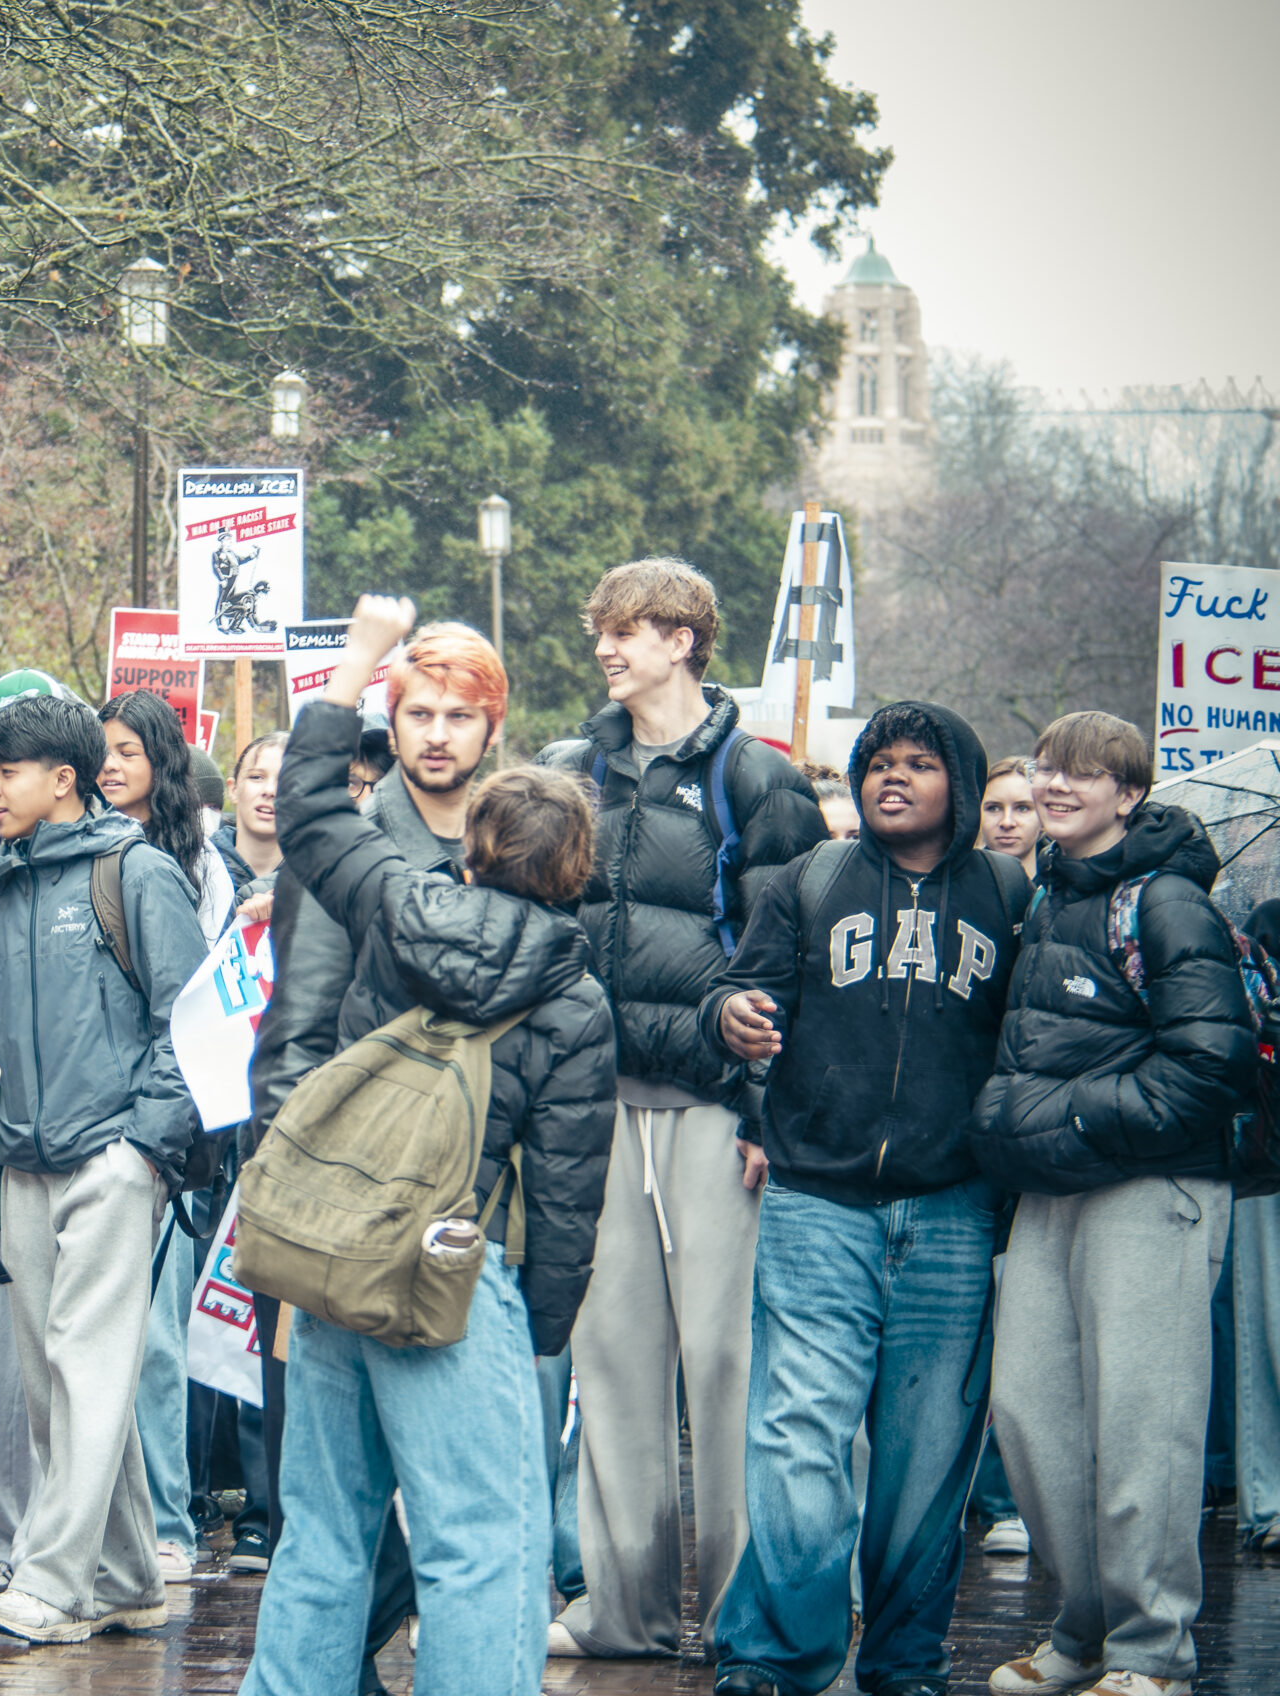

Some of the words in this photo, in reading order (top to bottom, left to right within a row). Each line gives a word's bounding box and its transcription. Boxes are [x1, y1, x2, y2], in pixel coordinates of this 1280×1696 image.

[185, 481, 255, 496] DEMOLISH
[258, 479, 295, 495] ICE!
[237, 510, 264, 526] RACIST
[240, 523, 266, 539] POLICE
[267, 518, 291, 532] STATE
[1165, 576, 1268, 621] Fuck
[288, 633, 349, 648] DEMOLIS
[113, 667, 197, 688] SUPPORT
[1171, 642, 1280, 691] ICE
[1161, 703, 1193, 726] NO
[1160, 747, 1194, 771] IS
[829, 911, 997, 1001] GAP
